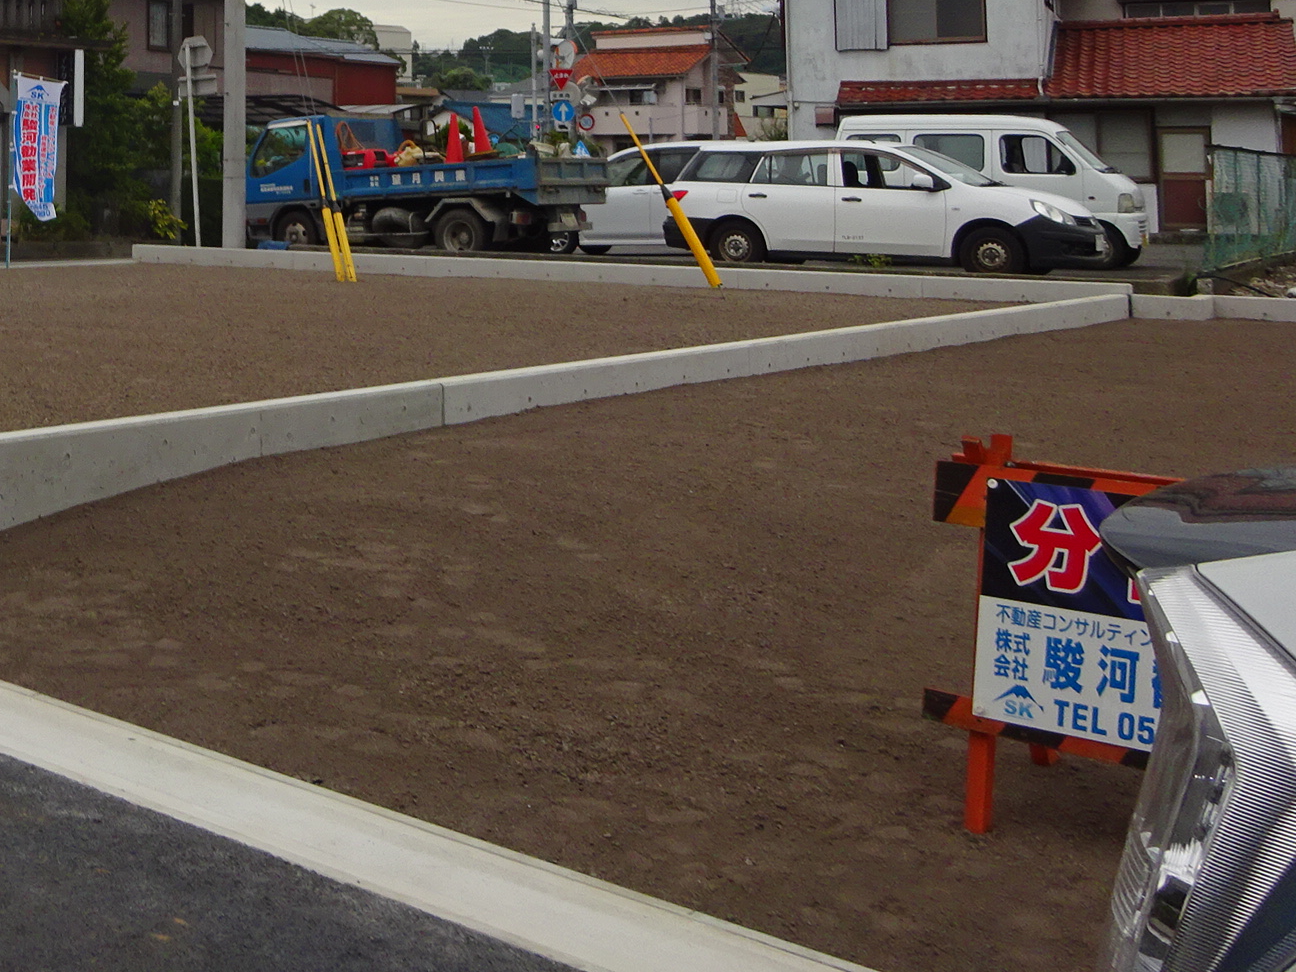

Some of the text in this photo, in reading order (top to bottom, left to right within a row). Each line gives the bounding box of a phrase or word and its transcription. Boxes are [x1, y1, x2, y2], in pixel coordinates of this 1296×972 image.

[30, 91, 44, 100] SK
[994, 628, 1030, 656] 株式
[993, 655, 1029, 682] 会社
[1042, 635, 1162, 710] 駿河
[1003, 699, 1034, 719] SK
[1053, 698, 1155, 745] TEL 05
